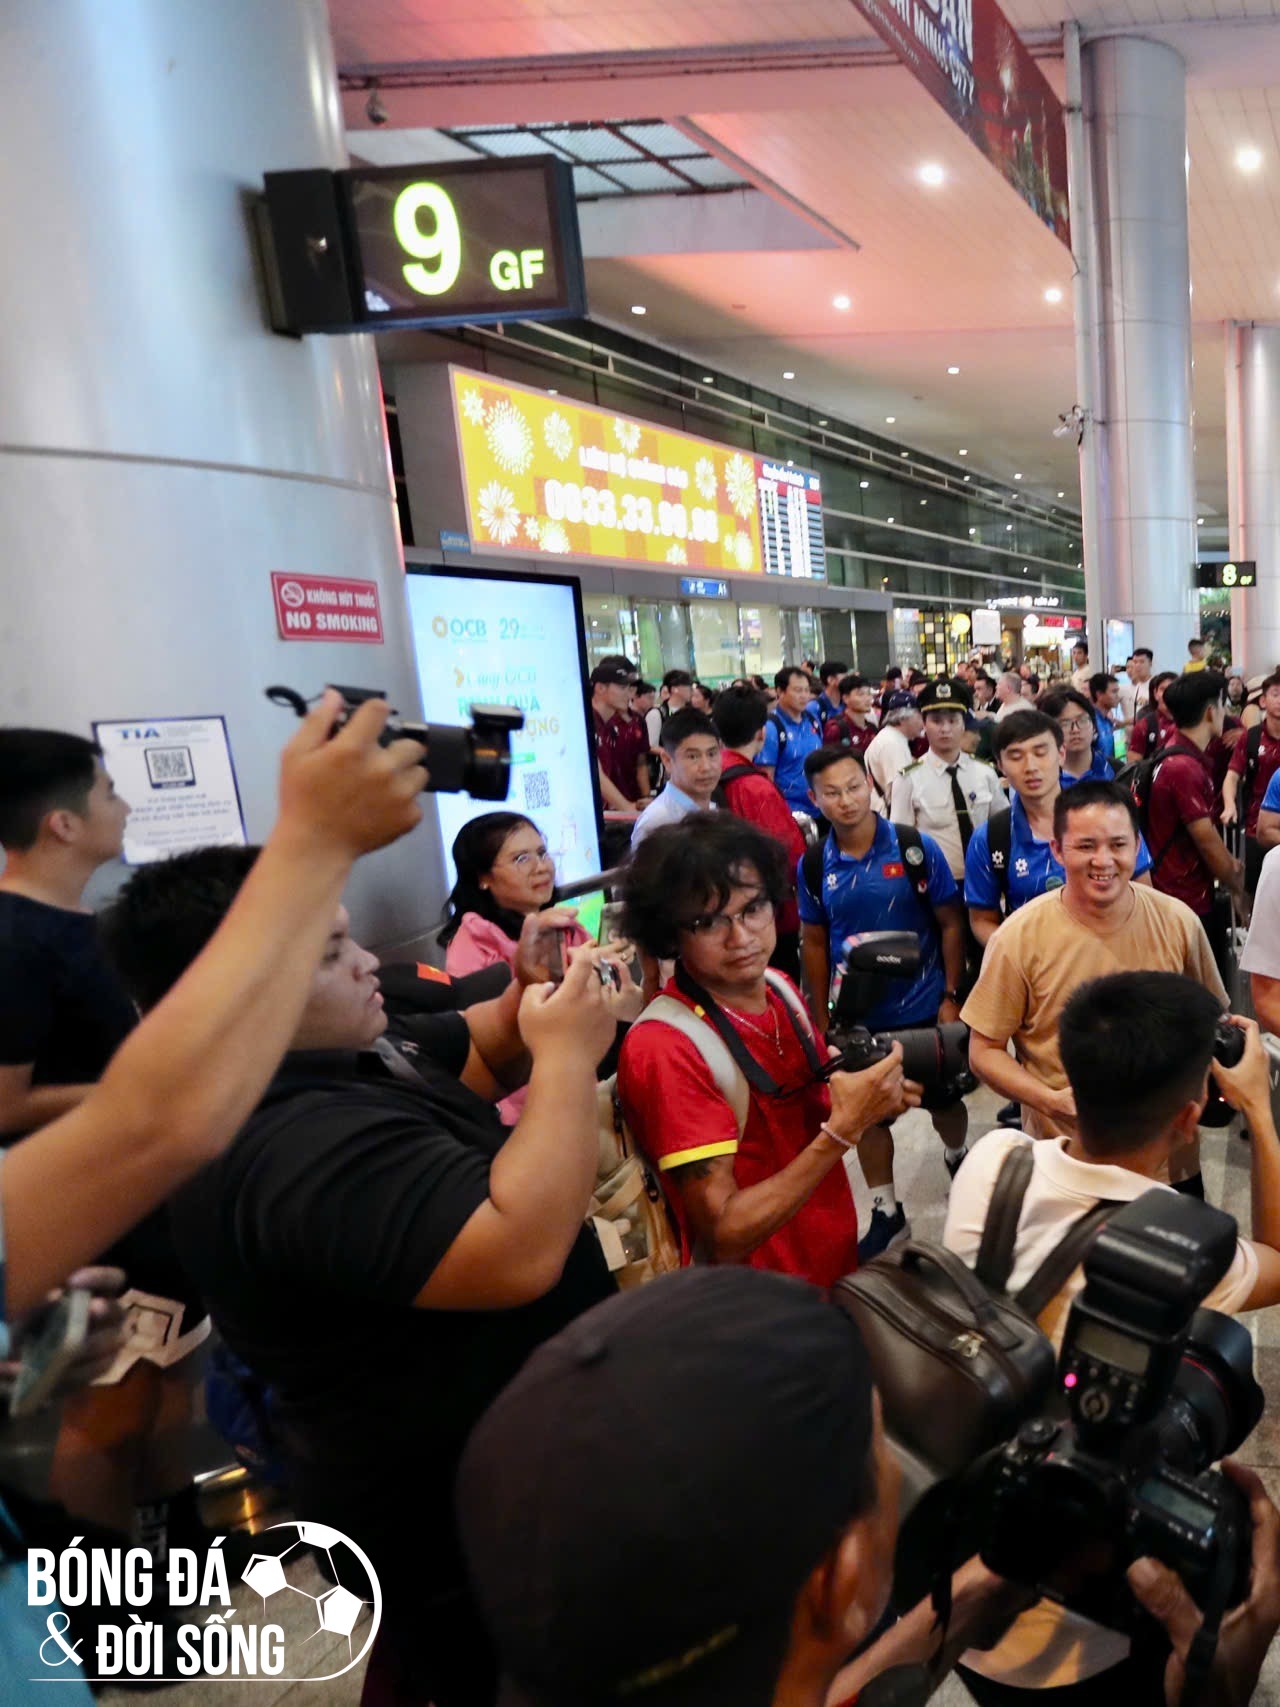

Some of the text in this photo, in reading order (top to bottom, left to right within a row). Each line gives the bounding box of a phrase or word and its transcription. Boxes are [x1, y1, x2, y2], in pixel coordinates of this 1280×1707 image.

[914, 1, 949, 74] MINH
[393, 181, 545, 297] 9 GF
[1223, 564, 1237, 586] 8
[286, 611, 378, 632] NO SMOKING
[450, 618, 487, 637] OCB
[499, 617, 520, 639] 29
[117, 727, 160, 740] TIA
